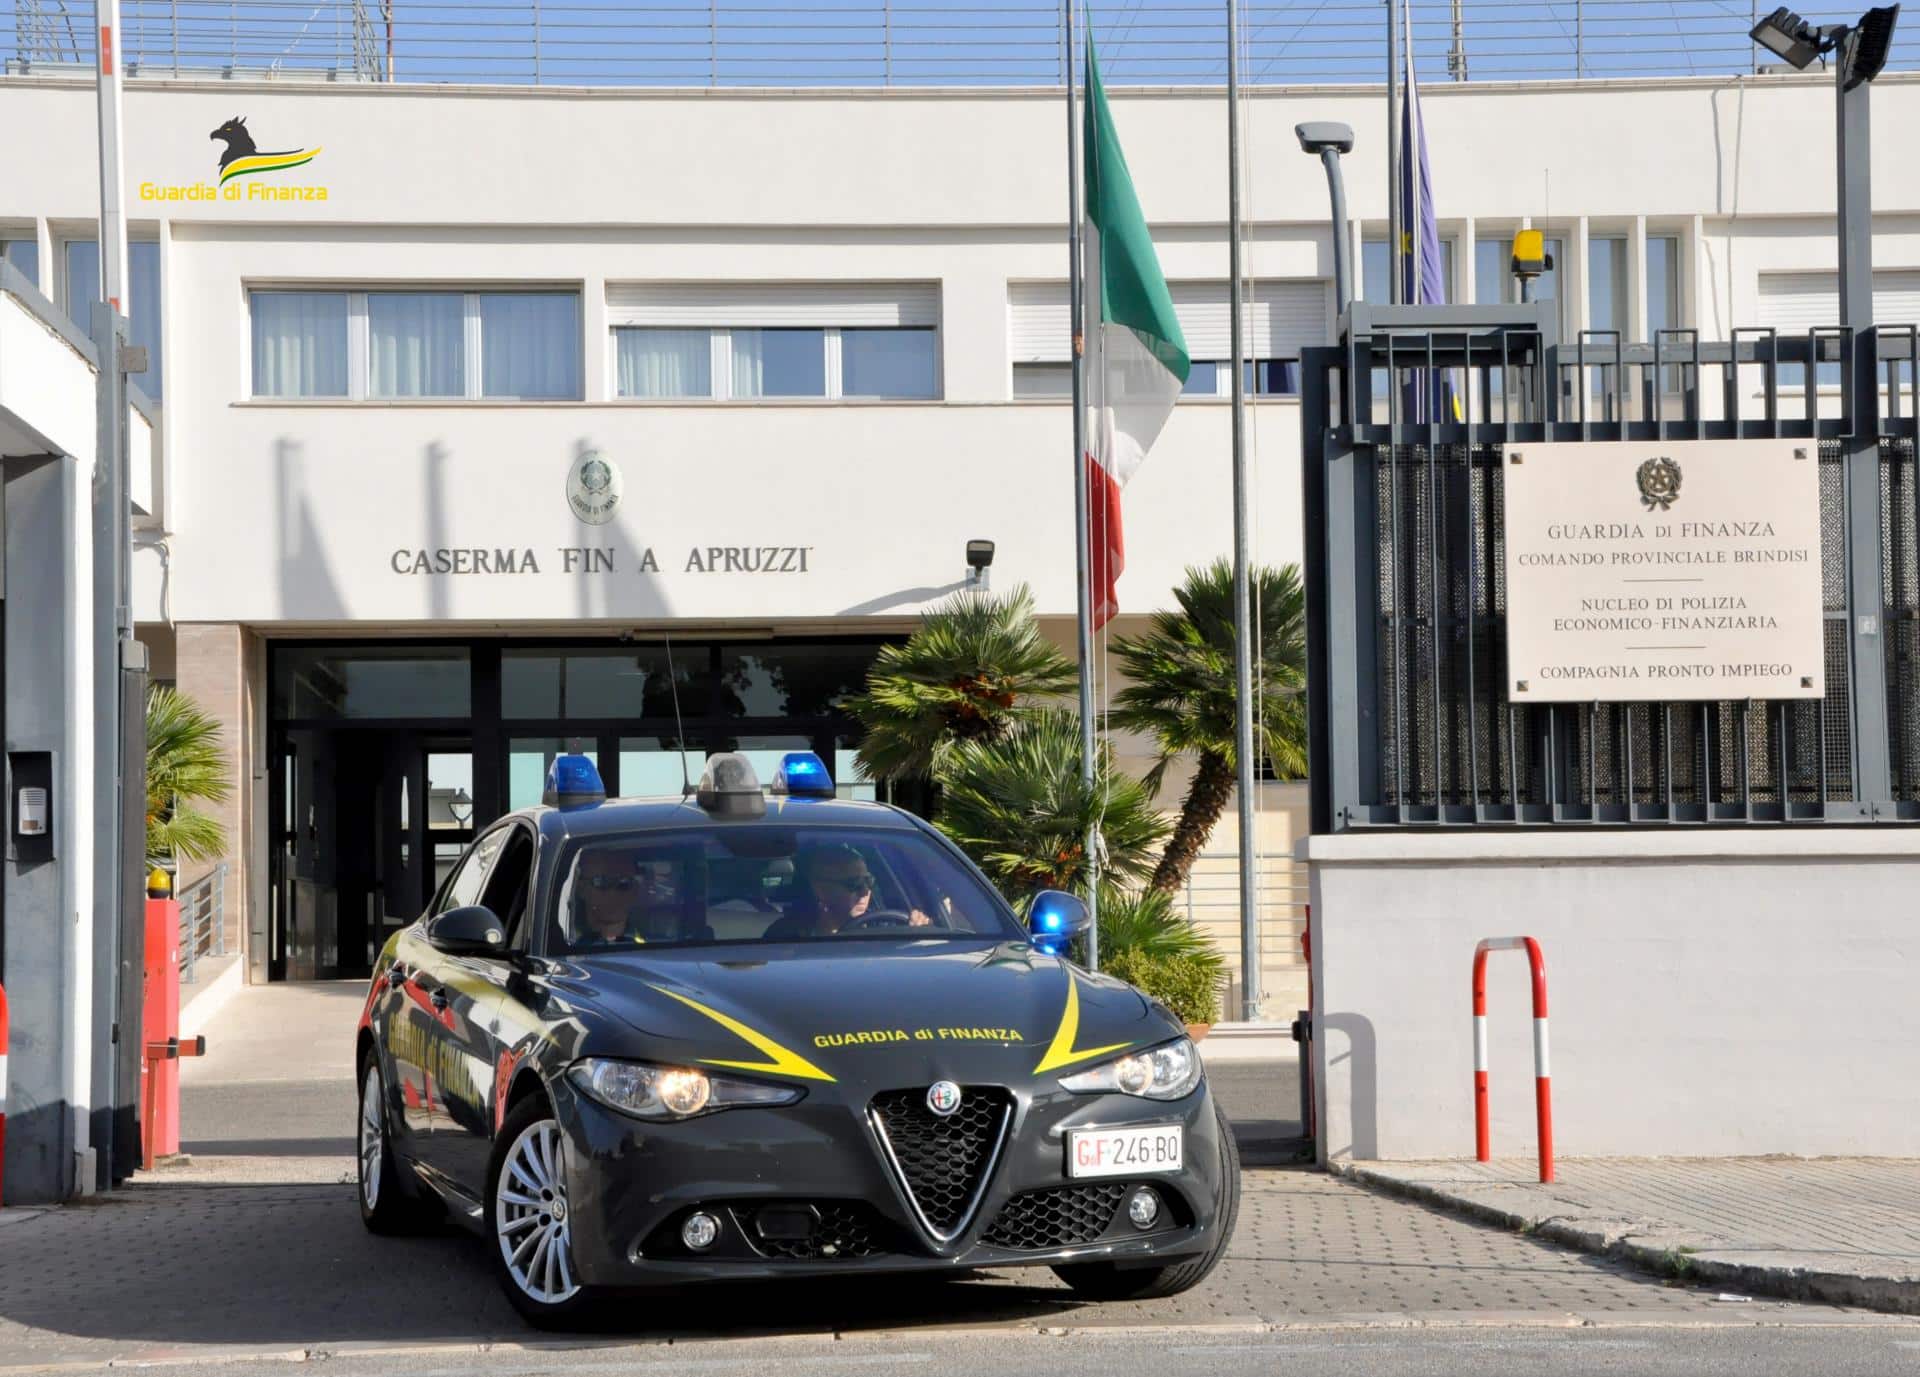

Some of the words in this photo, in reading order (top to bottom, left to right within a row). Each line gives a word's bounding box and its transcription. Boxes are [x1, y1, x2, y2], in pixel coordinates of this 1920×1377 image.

[1548, 523, 1645, 540] GUARDIA
[1655, 526, 1672, 538] DI
[1681, 522, 1776, 538] FINANZA
[391, 548, 540, 575] CASERMA
[1519, 552, 1605, 566] COMANDO
[1611, 550, 1727, 565] PROVINCIALE
[1733, 549, 1809, 563] BRINDISI
[1581, 598, 1649, 612] NUCLEO
[1656, 598, 1673, 610] DI
[1681, 596, 1748, 610] POLIZIA
[1540, 665, 1640, 679] COMPAGNIA
[1647, 664, 1715, 678] PRONTO
[1721, 663, 1793, 677] IMPIEGO
[814, 1029, 910, 1048] GUARDIA
[914, 1028, 934, 1040] di
[937, 1028, 1024, 1041] FINANZA
